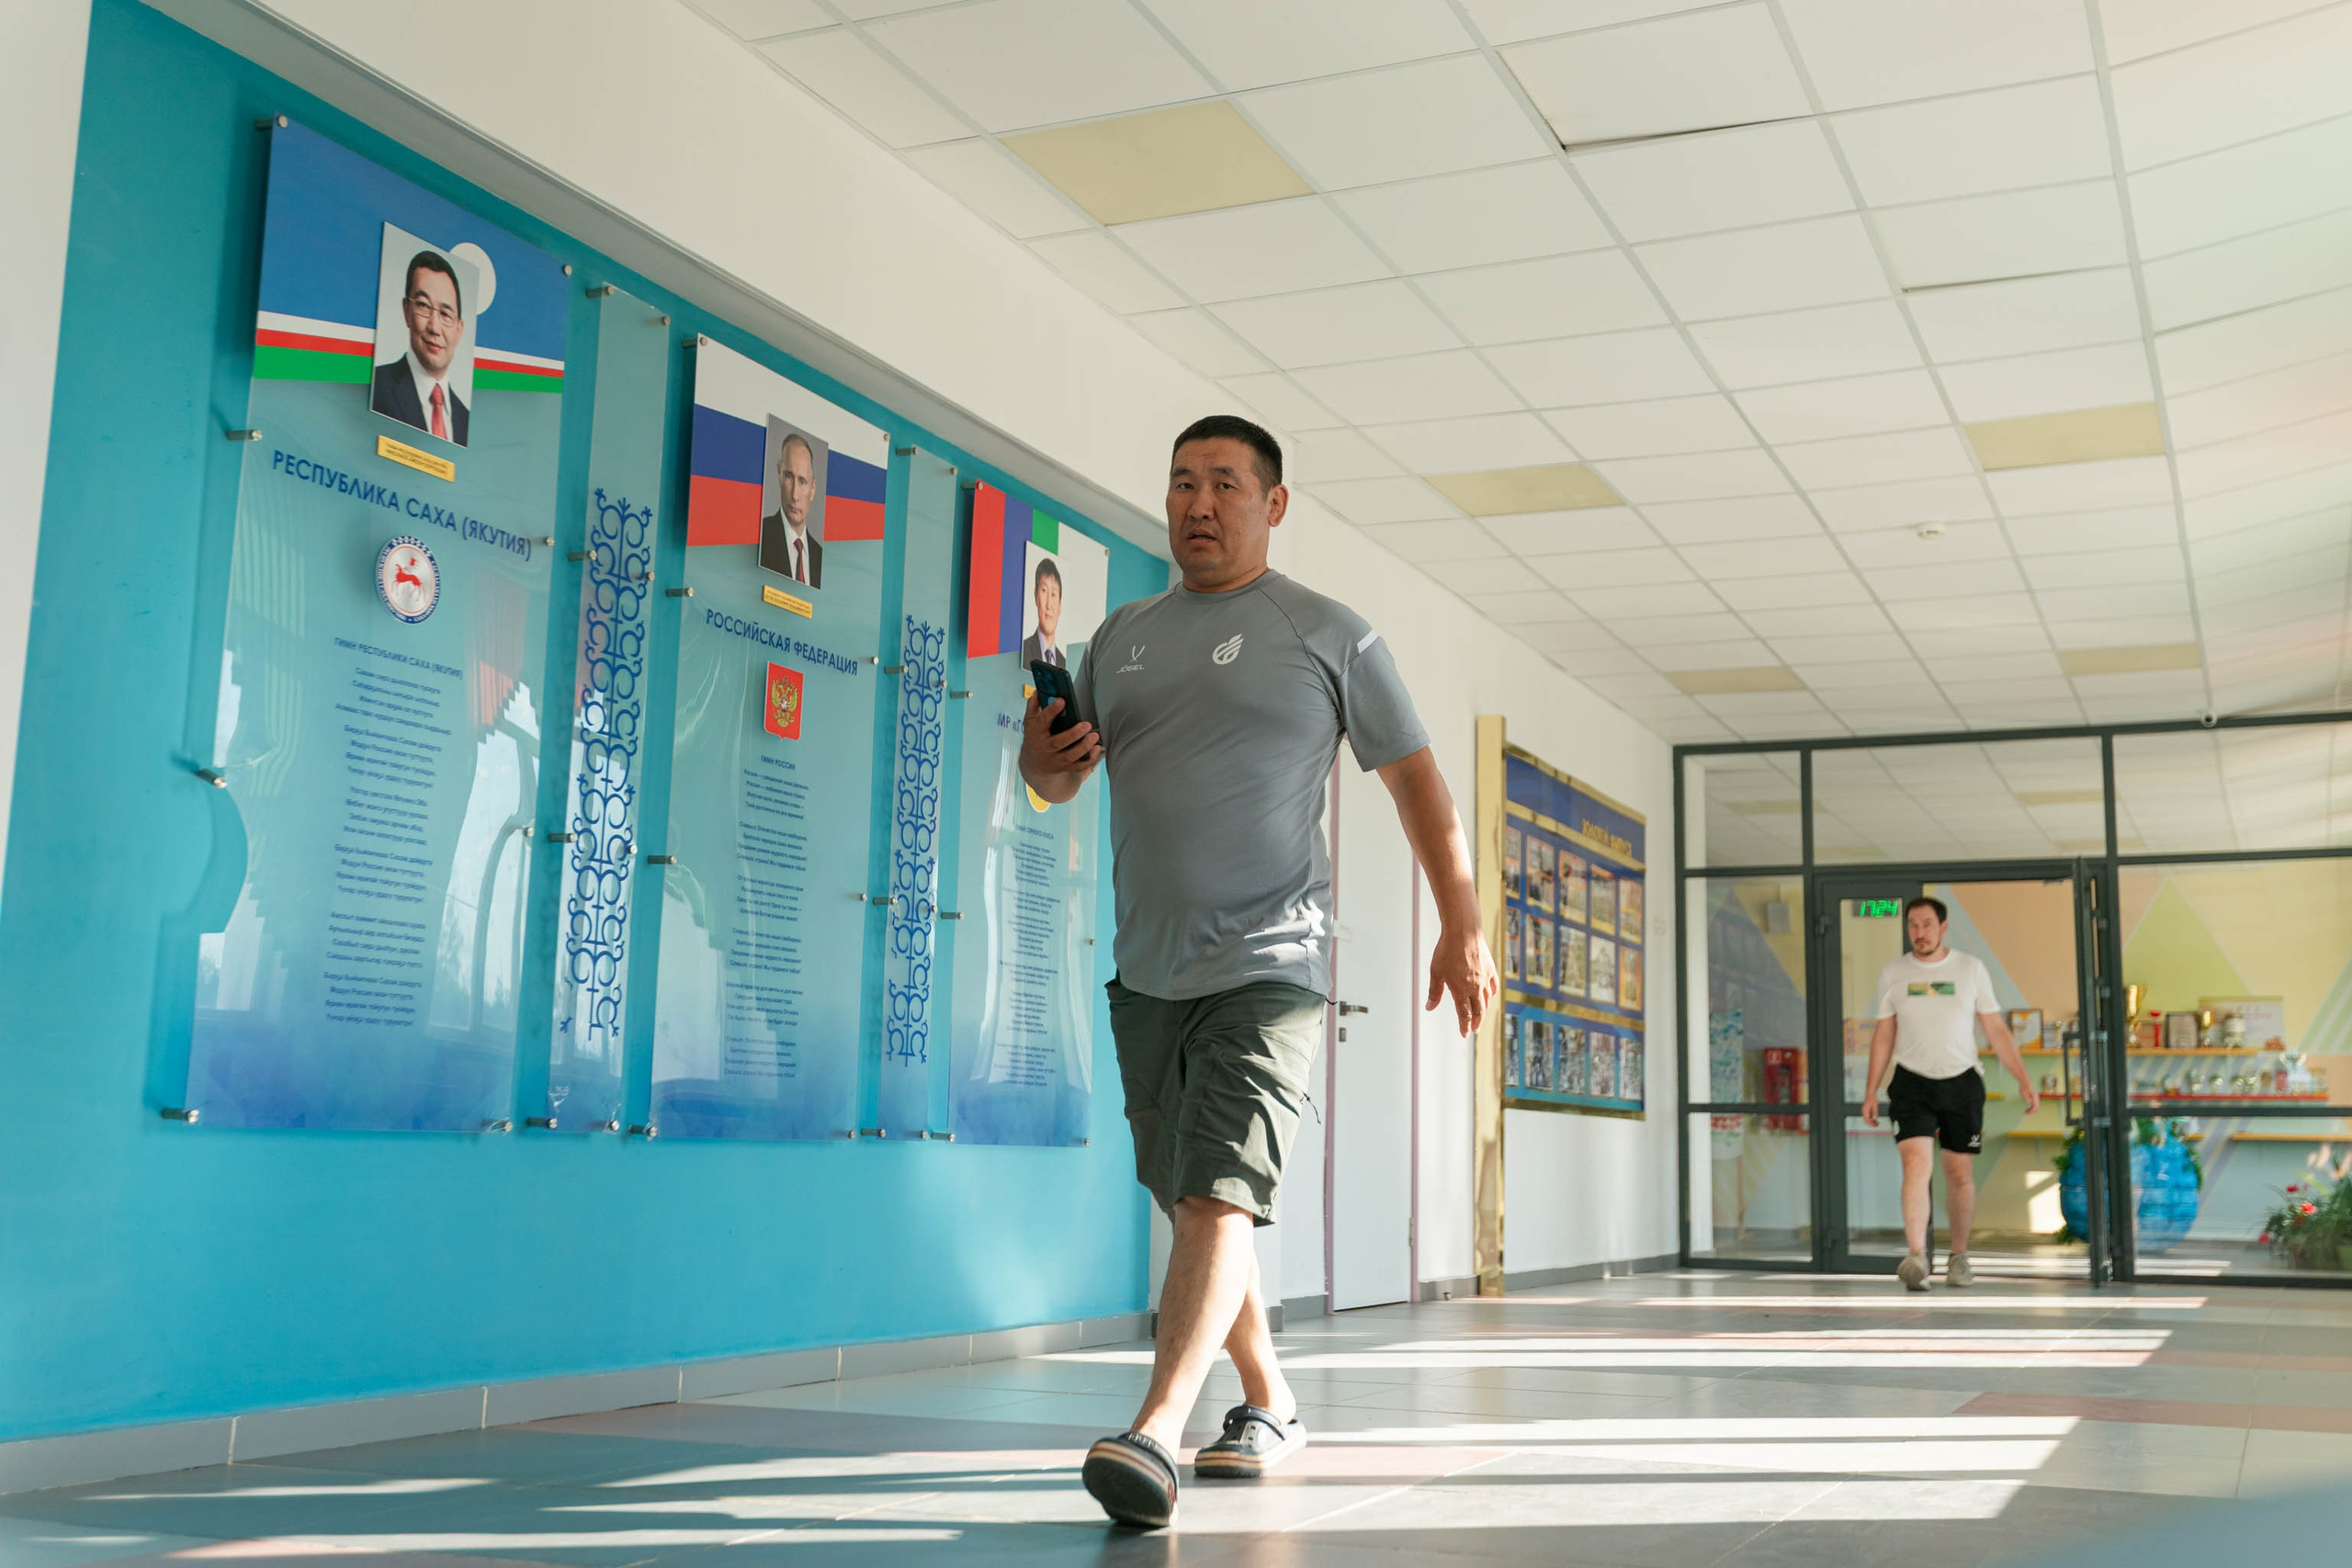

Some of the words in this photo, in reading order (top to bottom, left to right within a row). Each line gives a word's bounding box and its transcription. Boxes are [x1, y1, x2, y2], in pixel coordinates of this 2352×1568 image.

[273, 450, 400, 512] РЕСПУБЛИКА
[406, 498, 457, 531] САХА
[462, 516, 531, 561] (ЯКУТИЯ)
[707, 608, 790, 653] РОССИЙСКАЯ
[794, 641, 858, 676] ФЕДЕРАЦИЯ
[998, 712, 1011, 729] МР
